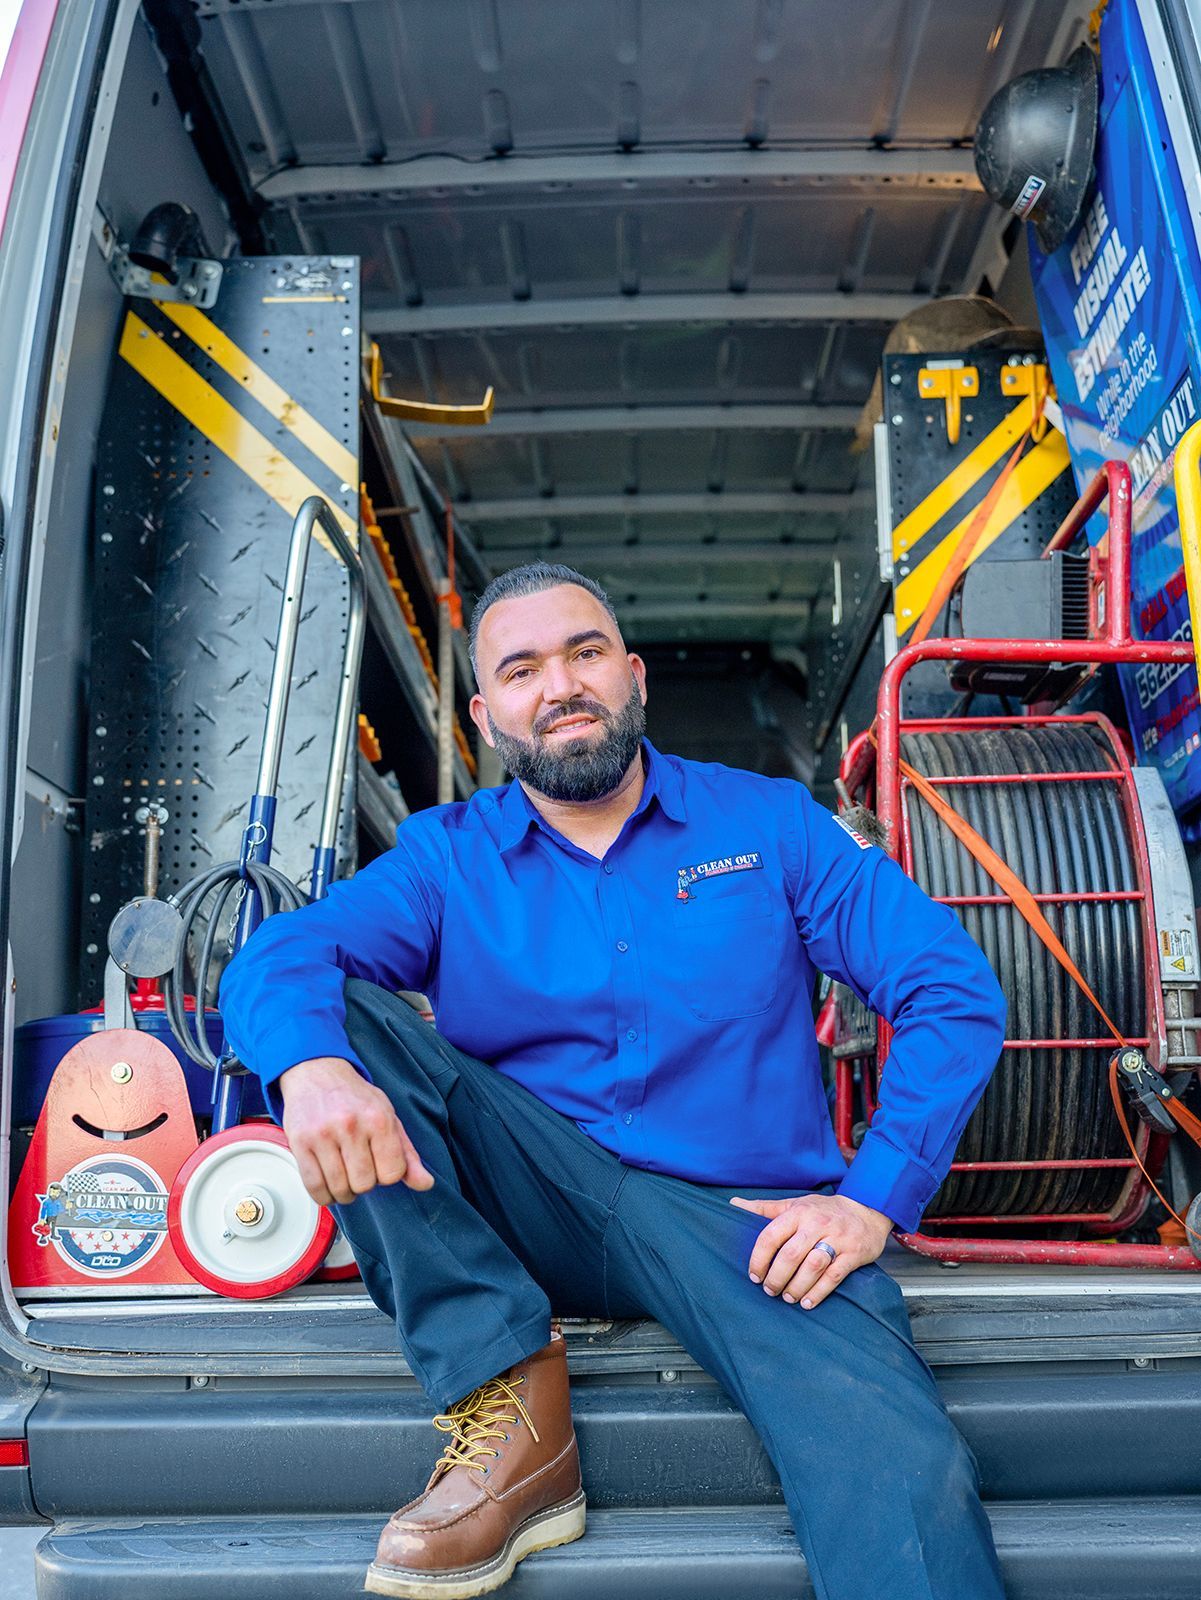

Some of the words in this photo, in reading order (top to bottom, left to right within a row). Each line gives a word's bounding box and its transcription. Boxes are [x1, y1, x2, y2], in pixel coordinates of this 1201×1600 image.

[1070, 191, 1109, 286] FREE
[1073, 226, 1127, 339] VISUAL
[1074, 245, 1151, 403] ESTIMATE!
[1096, 373, 1122, 421] While
[1119, 357, 1132, 384] in
[1128, 331, 1147, 367] the
[1099, 344, 1158, 451] neighborhood
[1161, 376, 1196, 447] OUT
[696, 857, 733, 874] CLEAN
[734, 853, 758, 865] OUT
[76, 1194, 129, 1210] CLEAN
[133, 1196, 168, 1211] OUT
